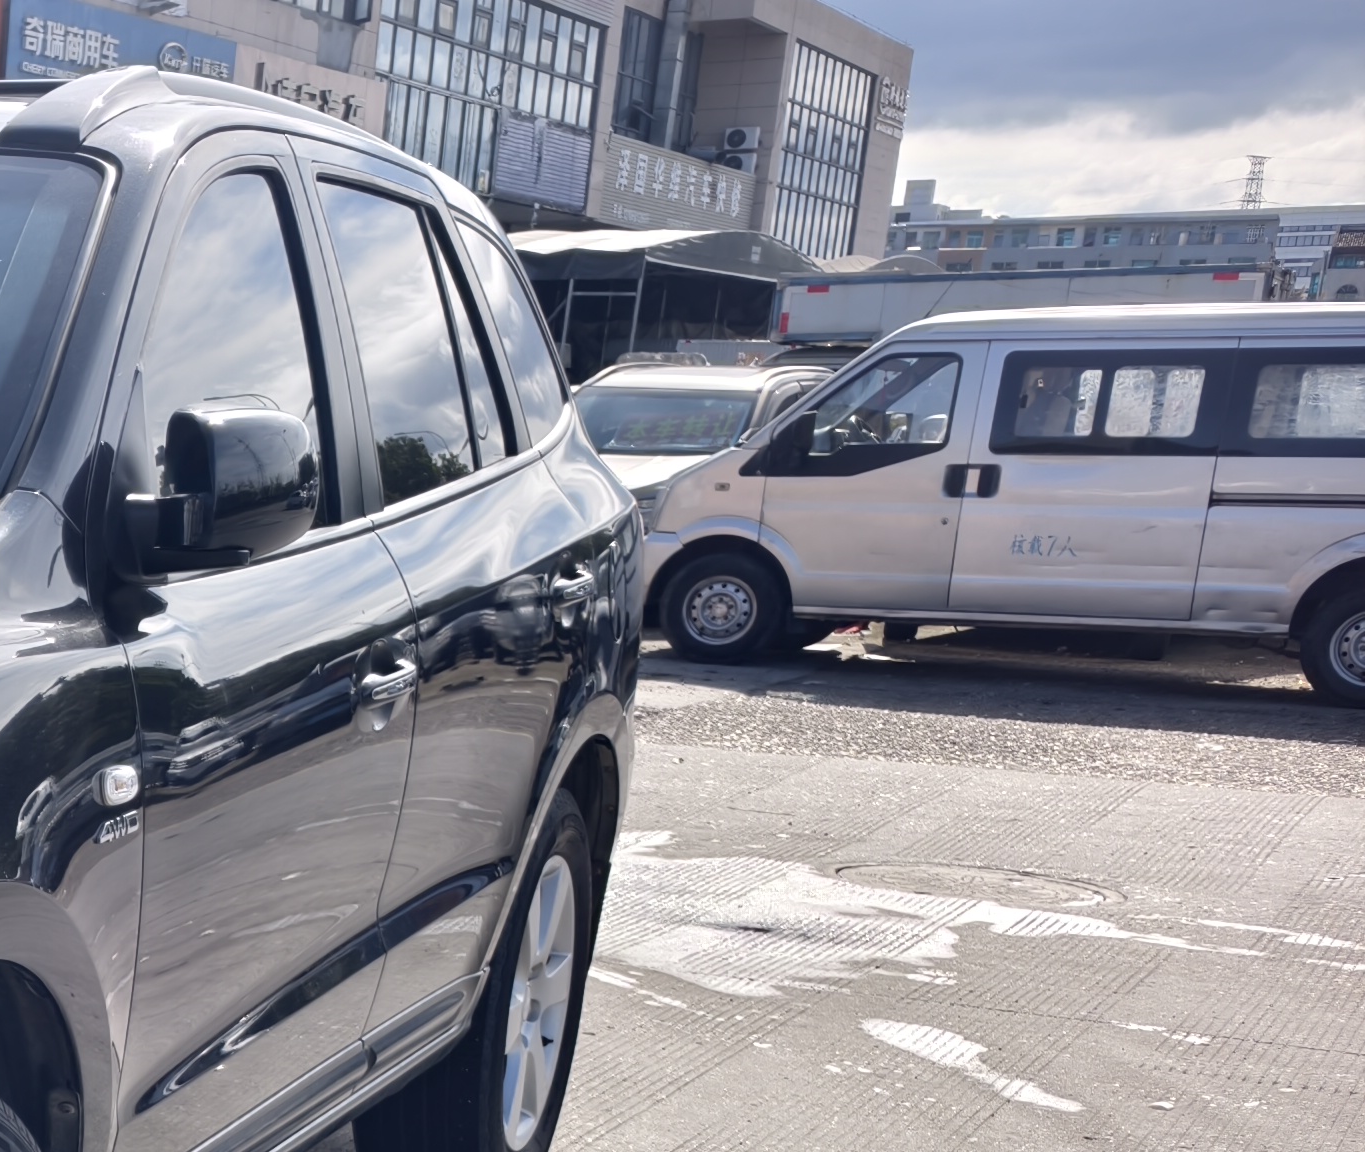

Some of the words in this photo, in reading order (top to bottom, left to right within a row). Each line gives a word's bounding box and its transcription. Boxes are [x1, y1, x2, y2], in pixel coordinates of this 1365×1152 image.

[24, 16, 120, 69] 奇瑞商用车
[99, 810, 139, 844] 4WD
